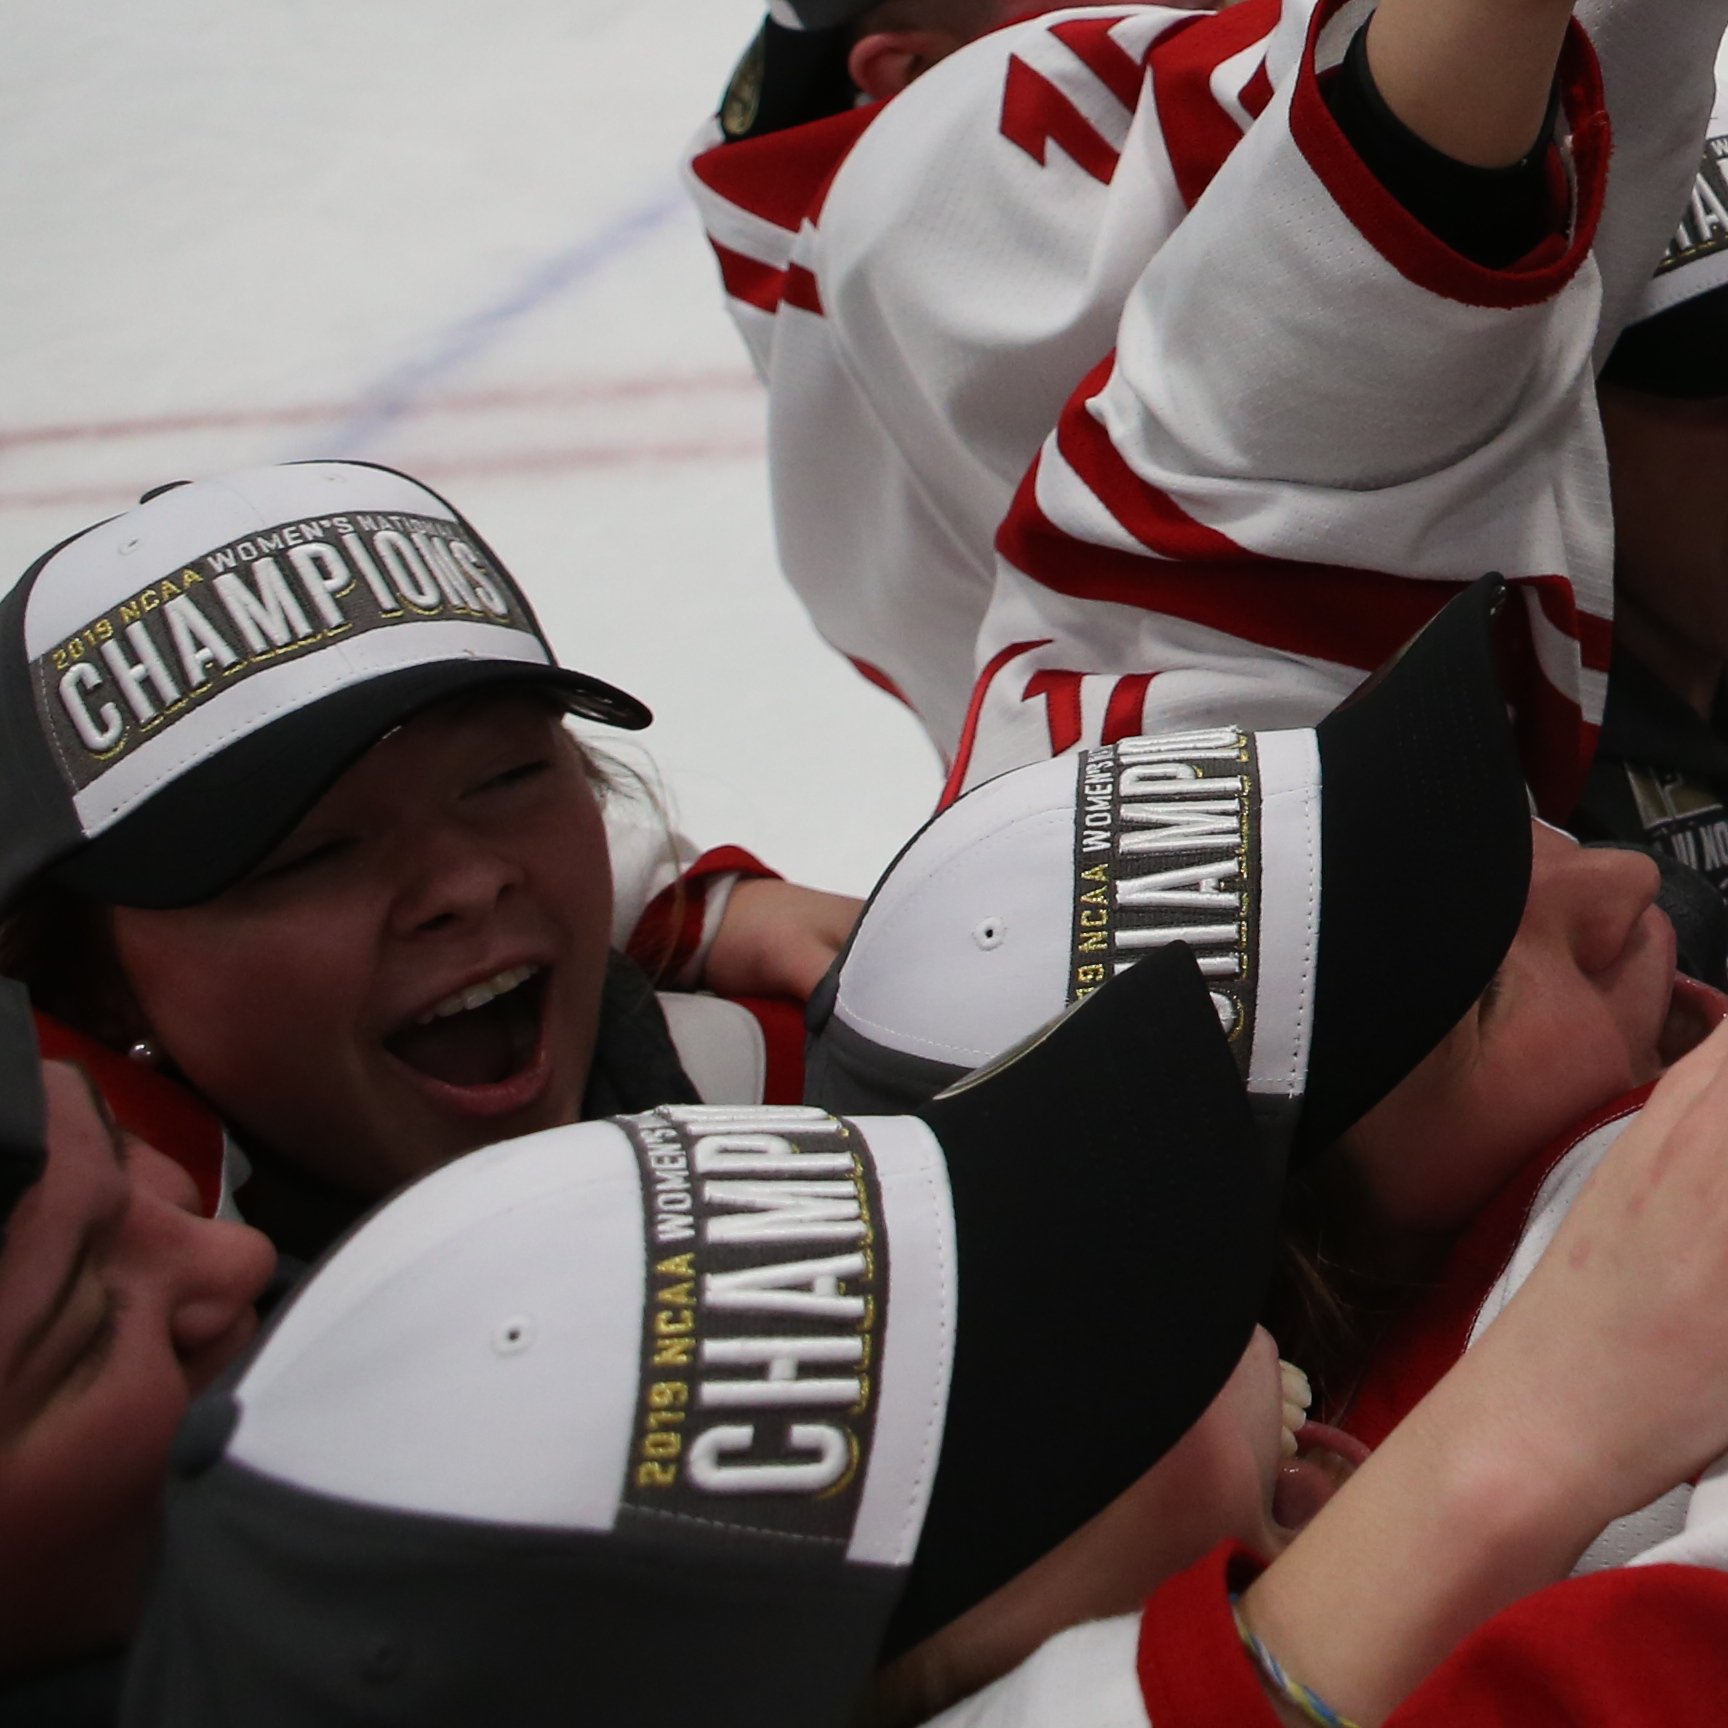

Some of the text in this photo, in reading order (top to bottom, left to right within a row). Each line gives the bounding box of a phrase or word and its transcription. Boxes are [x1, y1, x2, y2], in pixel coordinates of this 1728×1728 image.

[50, 615, 115, 673] 2019
[118, 567, 204, 624] NCAA
[207, 516, 353, 573] WOMEN'S
[57, 530, 512, 756] CHAMPIONS
[1081, 760, 1114, 853] WOMEN'S
[1077, 863, 1110, 954] NCAA
[636, 1127, 697, 1488] 2019 NCAA WOMEN'S
